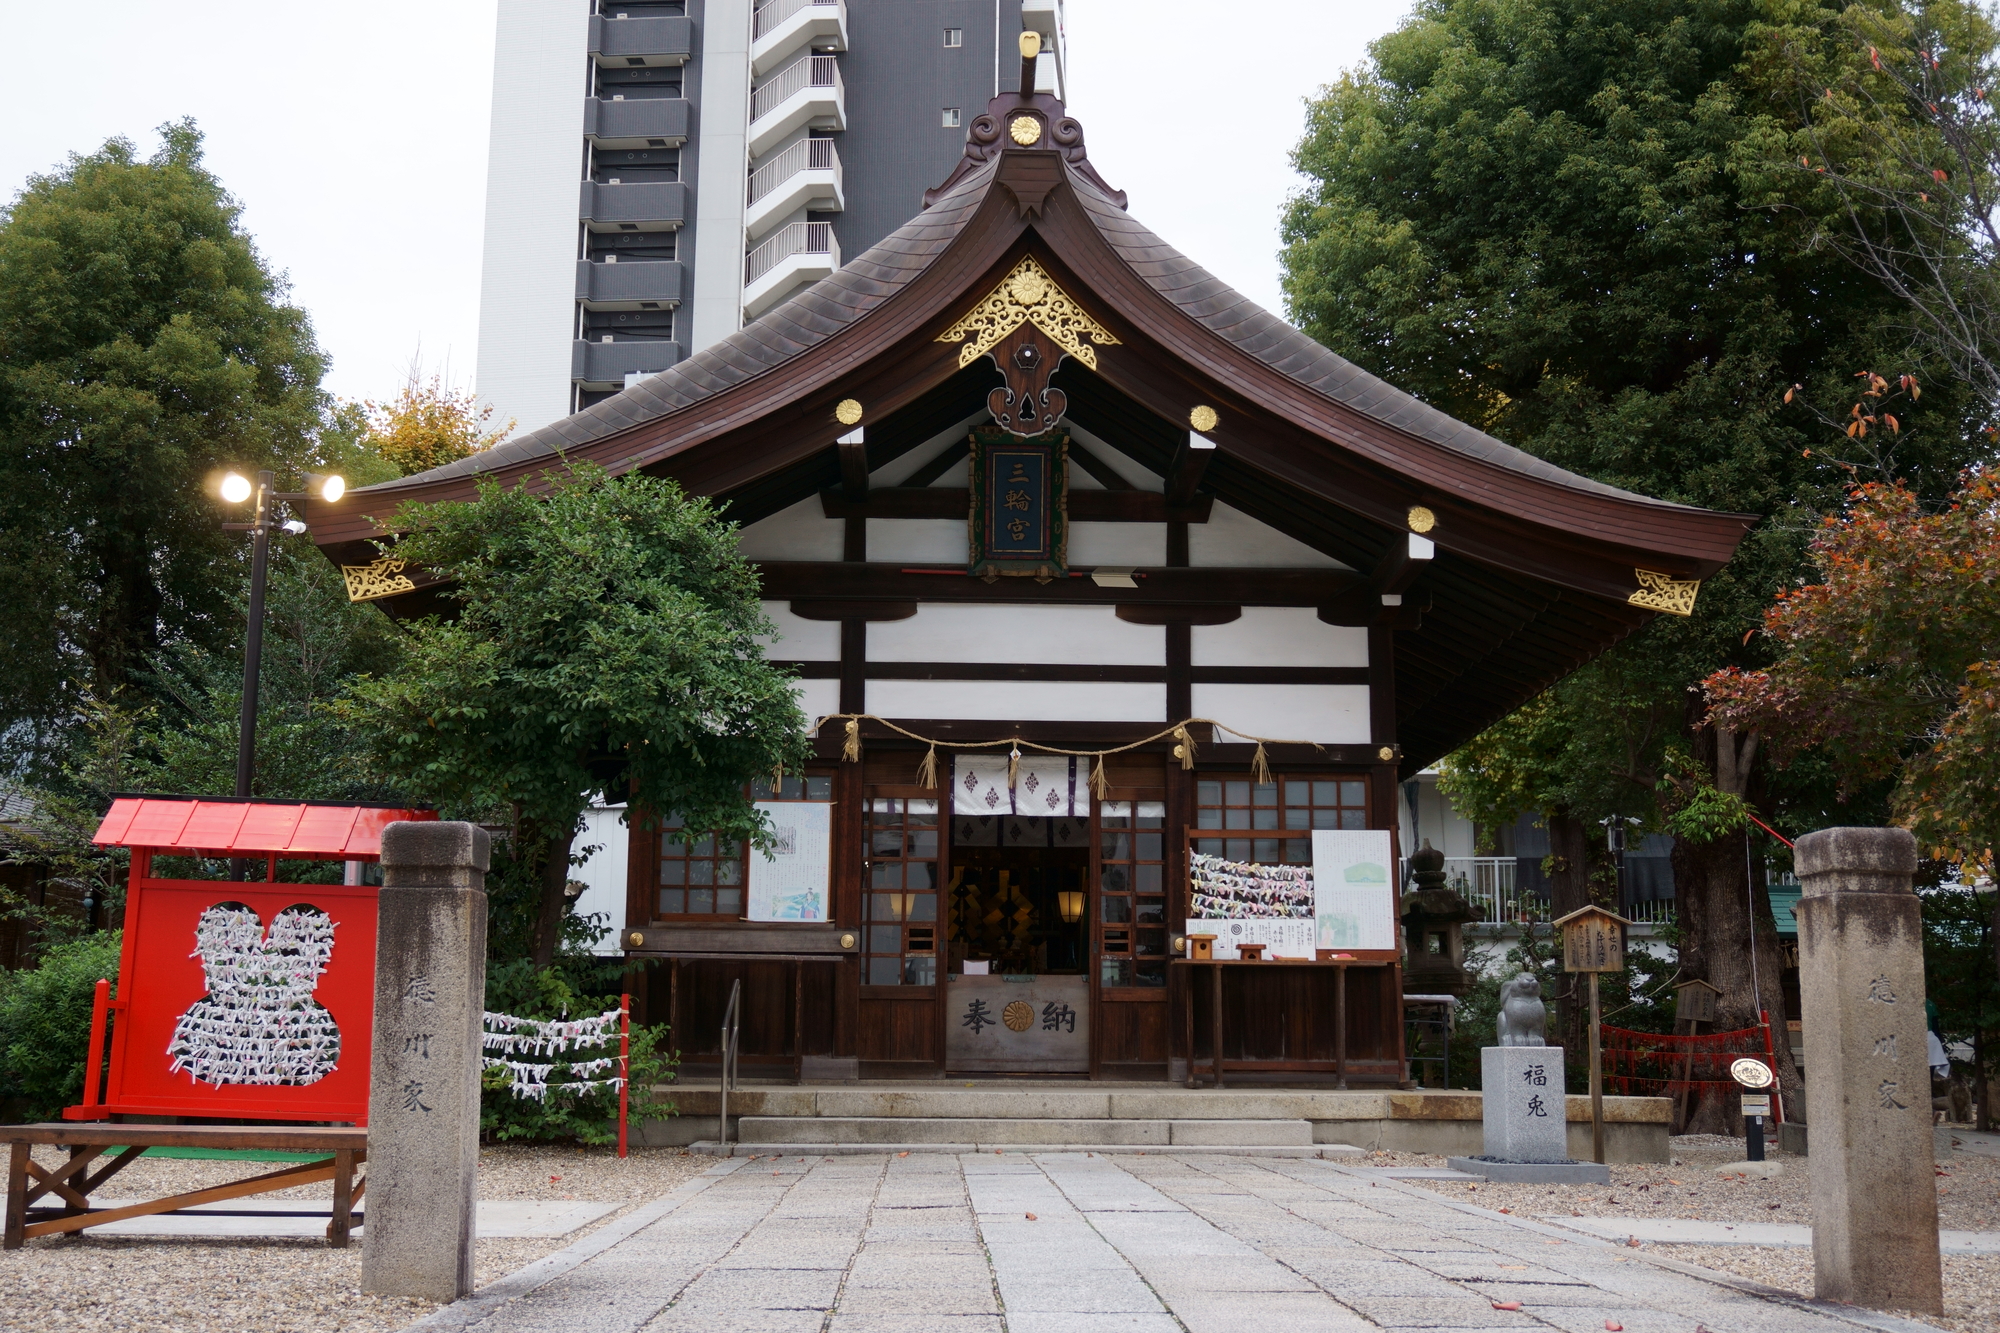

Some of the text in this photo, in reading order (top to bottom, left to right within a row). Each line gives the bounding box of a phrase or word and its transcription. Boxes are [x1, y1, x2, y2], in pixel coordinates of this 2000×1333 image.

[1003, 463, 1033, 542] 三輪宮
[1608, 924, 1617, 952] 幸せの
[402, 972, 436, 1113] 徳川家
[1868, 973, 1908, 1110] 徳川家
